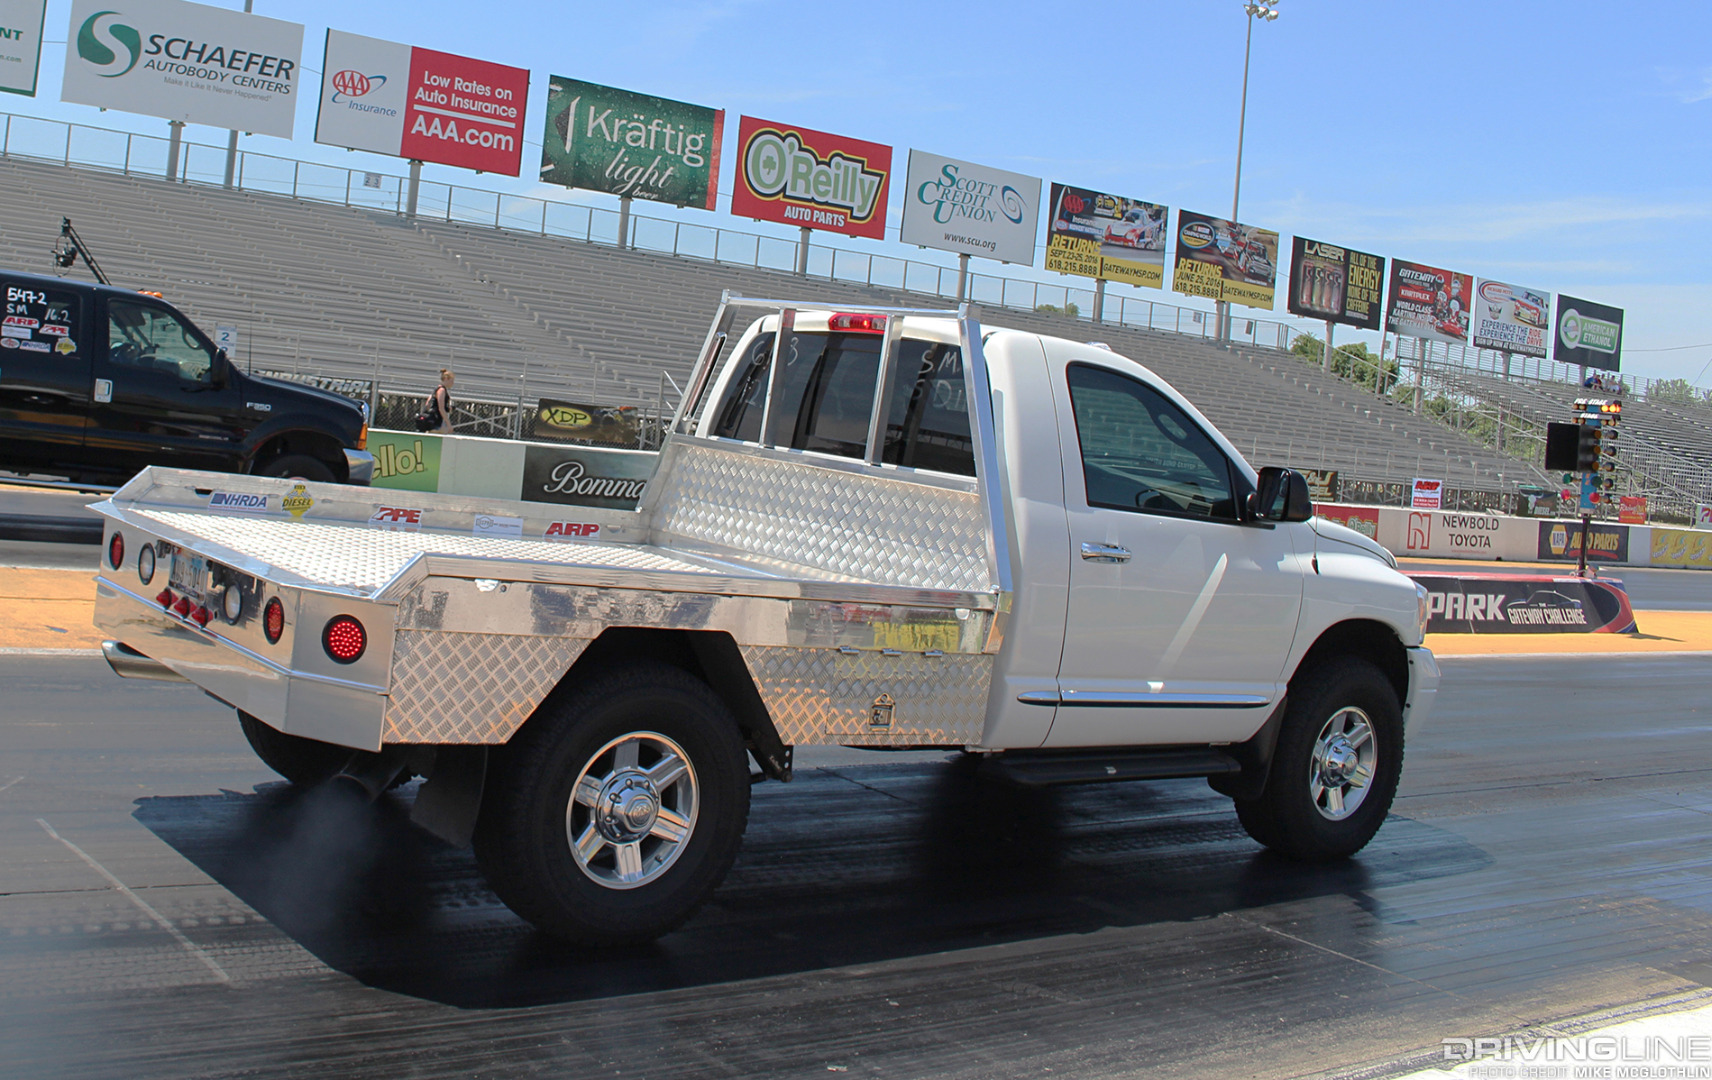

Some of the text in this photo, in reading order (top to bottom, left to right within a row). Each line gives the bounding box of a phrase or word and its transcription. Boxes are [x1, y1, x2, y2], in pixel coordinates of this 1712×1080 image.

[144, 34, 295, 81] SCHAEFER
[144, 59, 291, 94] AUTOBODY CENTERS
[336, 71, 367, 96] AAA
[424, 70, 513, 101] Low Rates on
[164, 76, 184, 87] Make
[190, 80, 205, 90] Like
[213, 84, 234, 96] Never
[235, 88, 269, 102] Happened
[348, 99, 397, 117] Insurance
[414, 87, 518, 118] Auto Insurance
[411, 115, 514, 152] AAA.com
[586, 105, 706, 168] Kräftig
[605, 148, 674, 195] light
[751, 139, 876, 213] O'Reilly
[938, 164, 998, 197] SCOTT
[632, 186, 659, 199] beer
[918, 181, 990, 208] CREDIT
[784, 205, 845, 227] AUTO PARTS
[933, 200, 997, 224] UNION
[944, 233, 996, 252] www.scu.org
[1051, 234, 1102, 255] RETURNS
[1304, 240, 1345, 262] LASER
[1103, 263, 1161, 280] GATEWAYMSP.COM
[1178, 257, 1223, 278] RETURNS
[1399, 268, 1436, 283] GATEWAY
[1177, 271, 1195, 282] JUNE
[1205, 277, 1221, 287] 2016
[1348, 264, 1381, 291] ENERGY
[1223, 286, 1273, 303] GATEWAYMSP.COM
[1401, 289, 1431, 301] KARTPLEX
[1396, 300, 1415, 311] WORLD
[5, 316, 39, 326] ARP
[1481, 319, 1542, 338] EXPERIENCE THE RIDE
[1583, 322, 1616, 337] AMERICAN
[221, 332, 230, 342] 2
[1479, 328, 1543, 347] EXPERIENCE THE DRIVE
[1583, 332, 1612, 347] ETHANOL
[546, 408, 587, 424] XDP
[220, 493, 267, 507] NHRDA
[281, 498, 311, 508] DIESEL
[545, 521, 600, 537] ARP
[1442, 515, 1499, 531] NEWBOLD
[1449, 533, 1491, 548] TOYOTA
[1570, 532, 1620, 551] AUO PARTS
[1428, 592, 1506, 621] PARK
[1507, 607, 1588, 625] GATEWAY CHALLENGE
